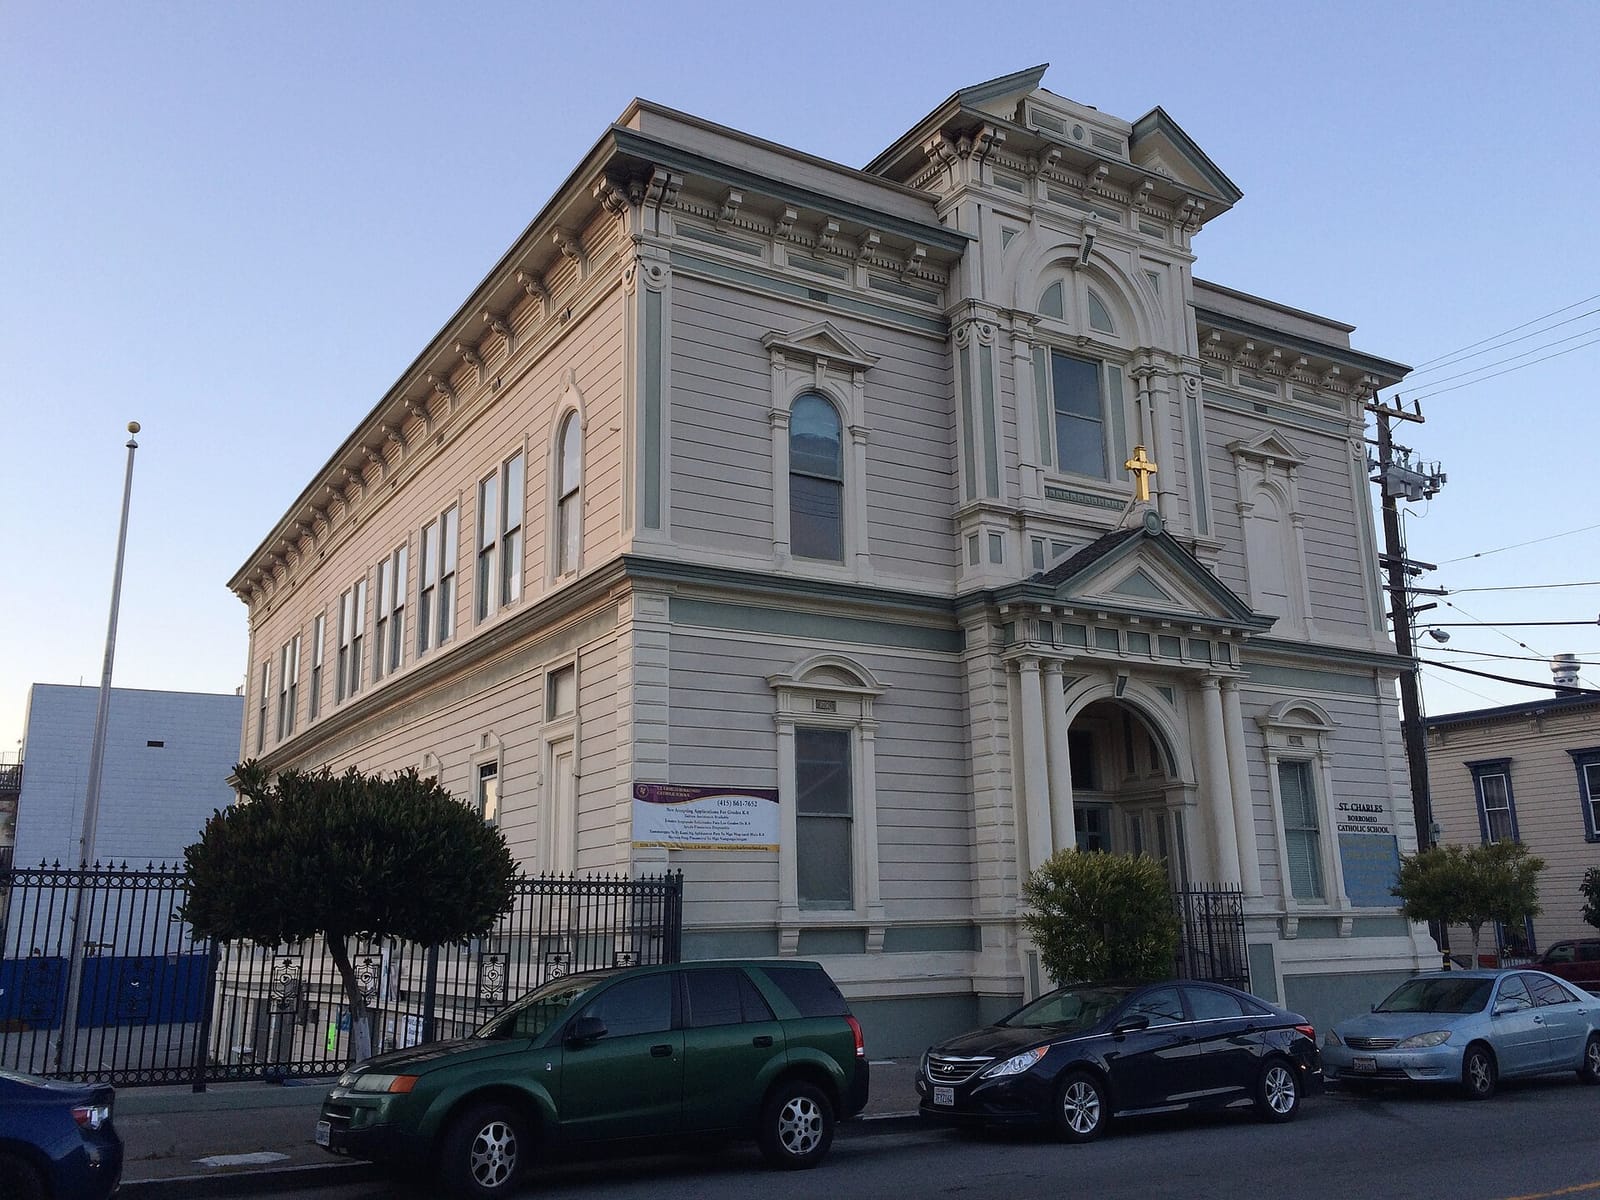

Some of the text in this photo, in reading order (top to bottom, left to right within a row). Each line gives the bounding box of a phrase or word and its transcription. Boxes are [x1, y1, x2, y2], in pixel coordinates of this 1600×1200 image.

[717, 799, 758, 808] (415) 861-7652
[1351, 804, 1383, 813] CHARLES
